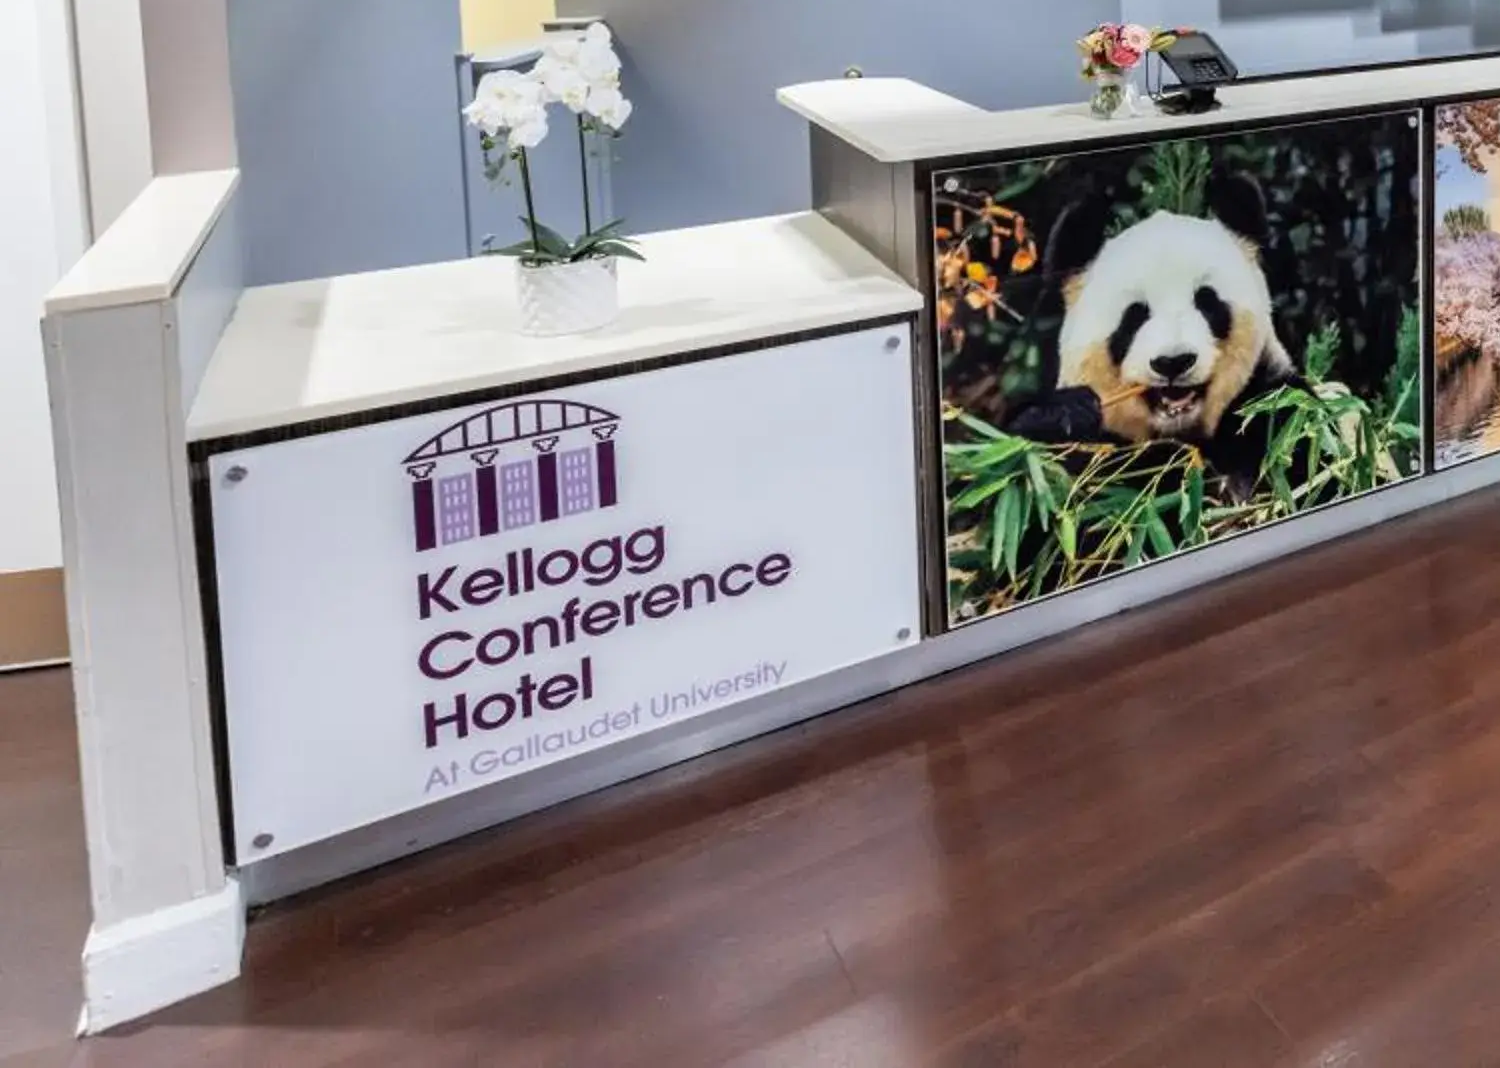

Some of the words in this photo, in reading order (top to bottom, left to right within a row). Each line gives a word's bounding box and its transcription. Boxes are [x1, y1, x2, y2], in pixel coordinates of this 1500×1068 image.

[417, 525, 665, 620] Kellogg
[418, 553, 792, 679] Conference
[423, 656, 593, 748] Hotel
[424, 762, 460, 793] At
[470, 703, 643, 776] Gallaudet
[650, 660, 788, 717] University
